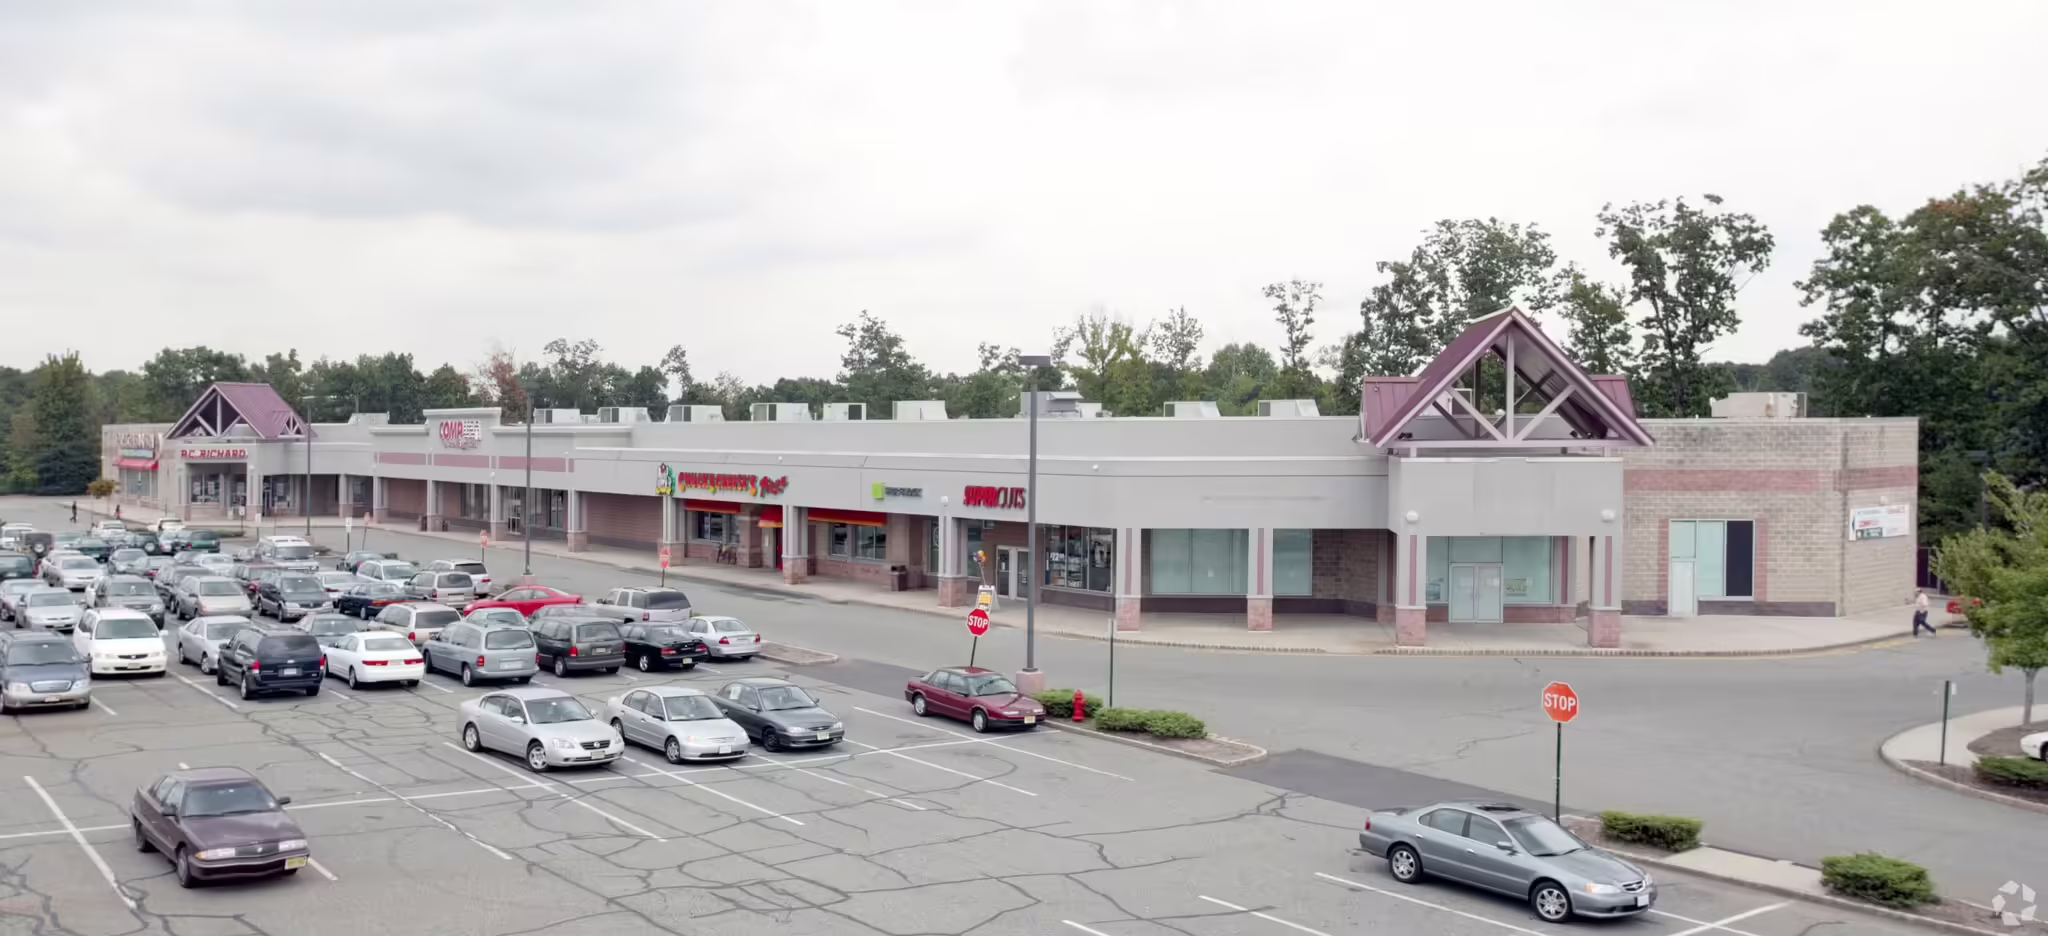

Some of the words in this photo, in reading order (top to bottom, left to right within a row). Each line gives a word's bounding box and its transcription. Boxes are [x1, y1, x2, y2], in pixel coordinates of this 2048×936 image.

[200, 449, 248, 458] RICHARD
[968, 615, 988, 629] STOP
[1544, 693, 1576, 712] STOP
